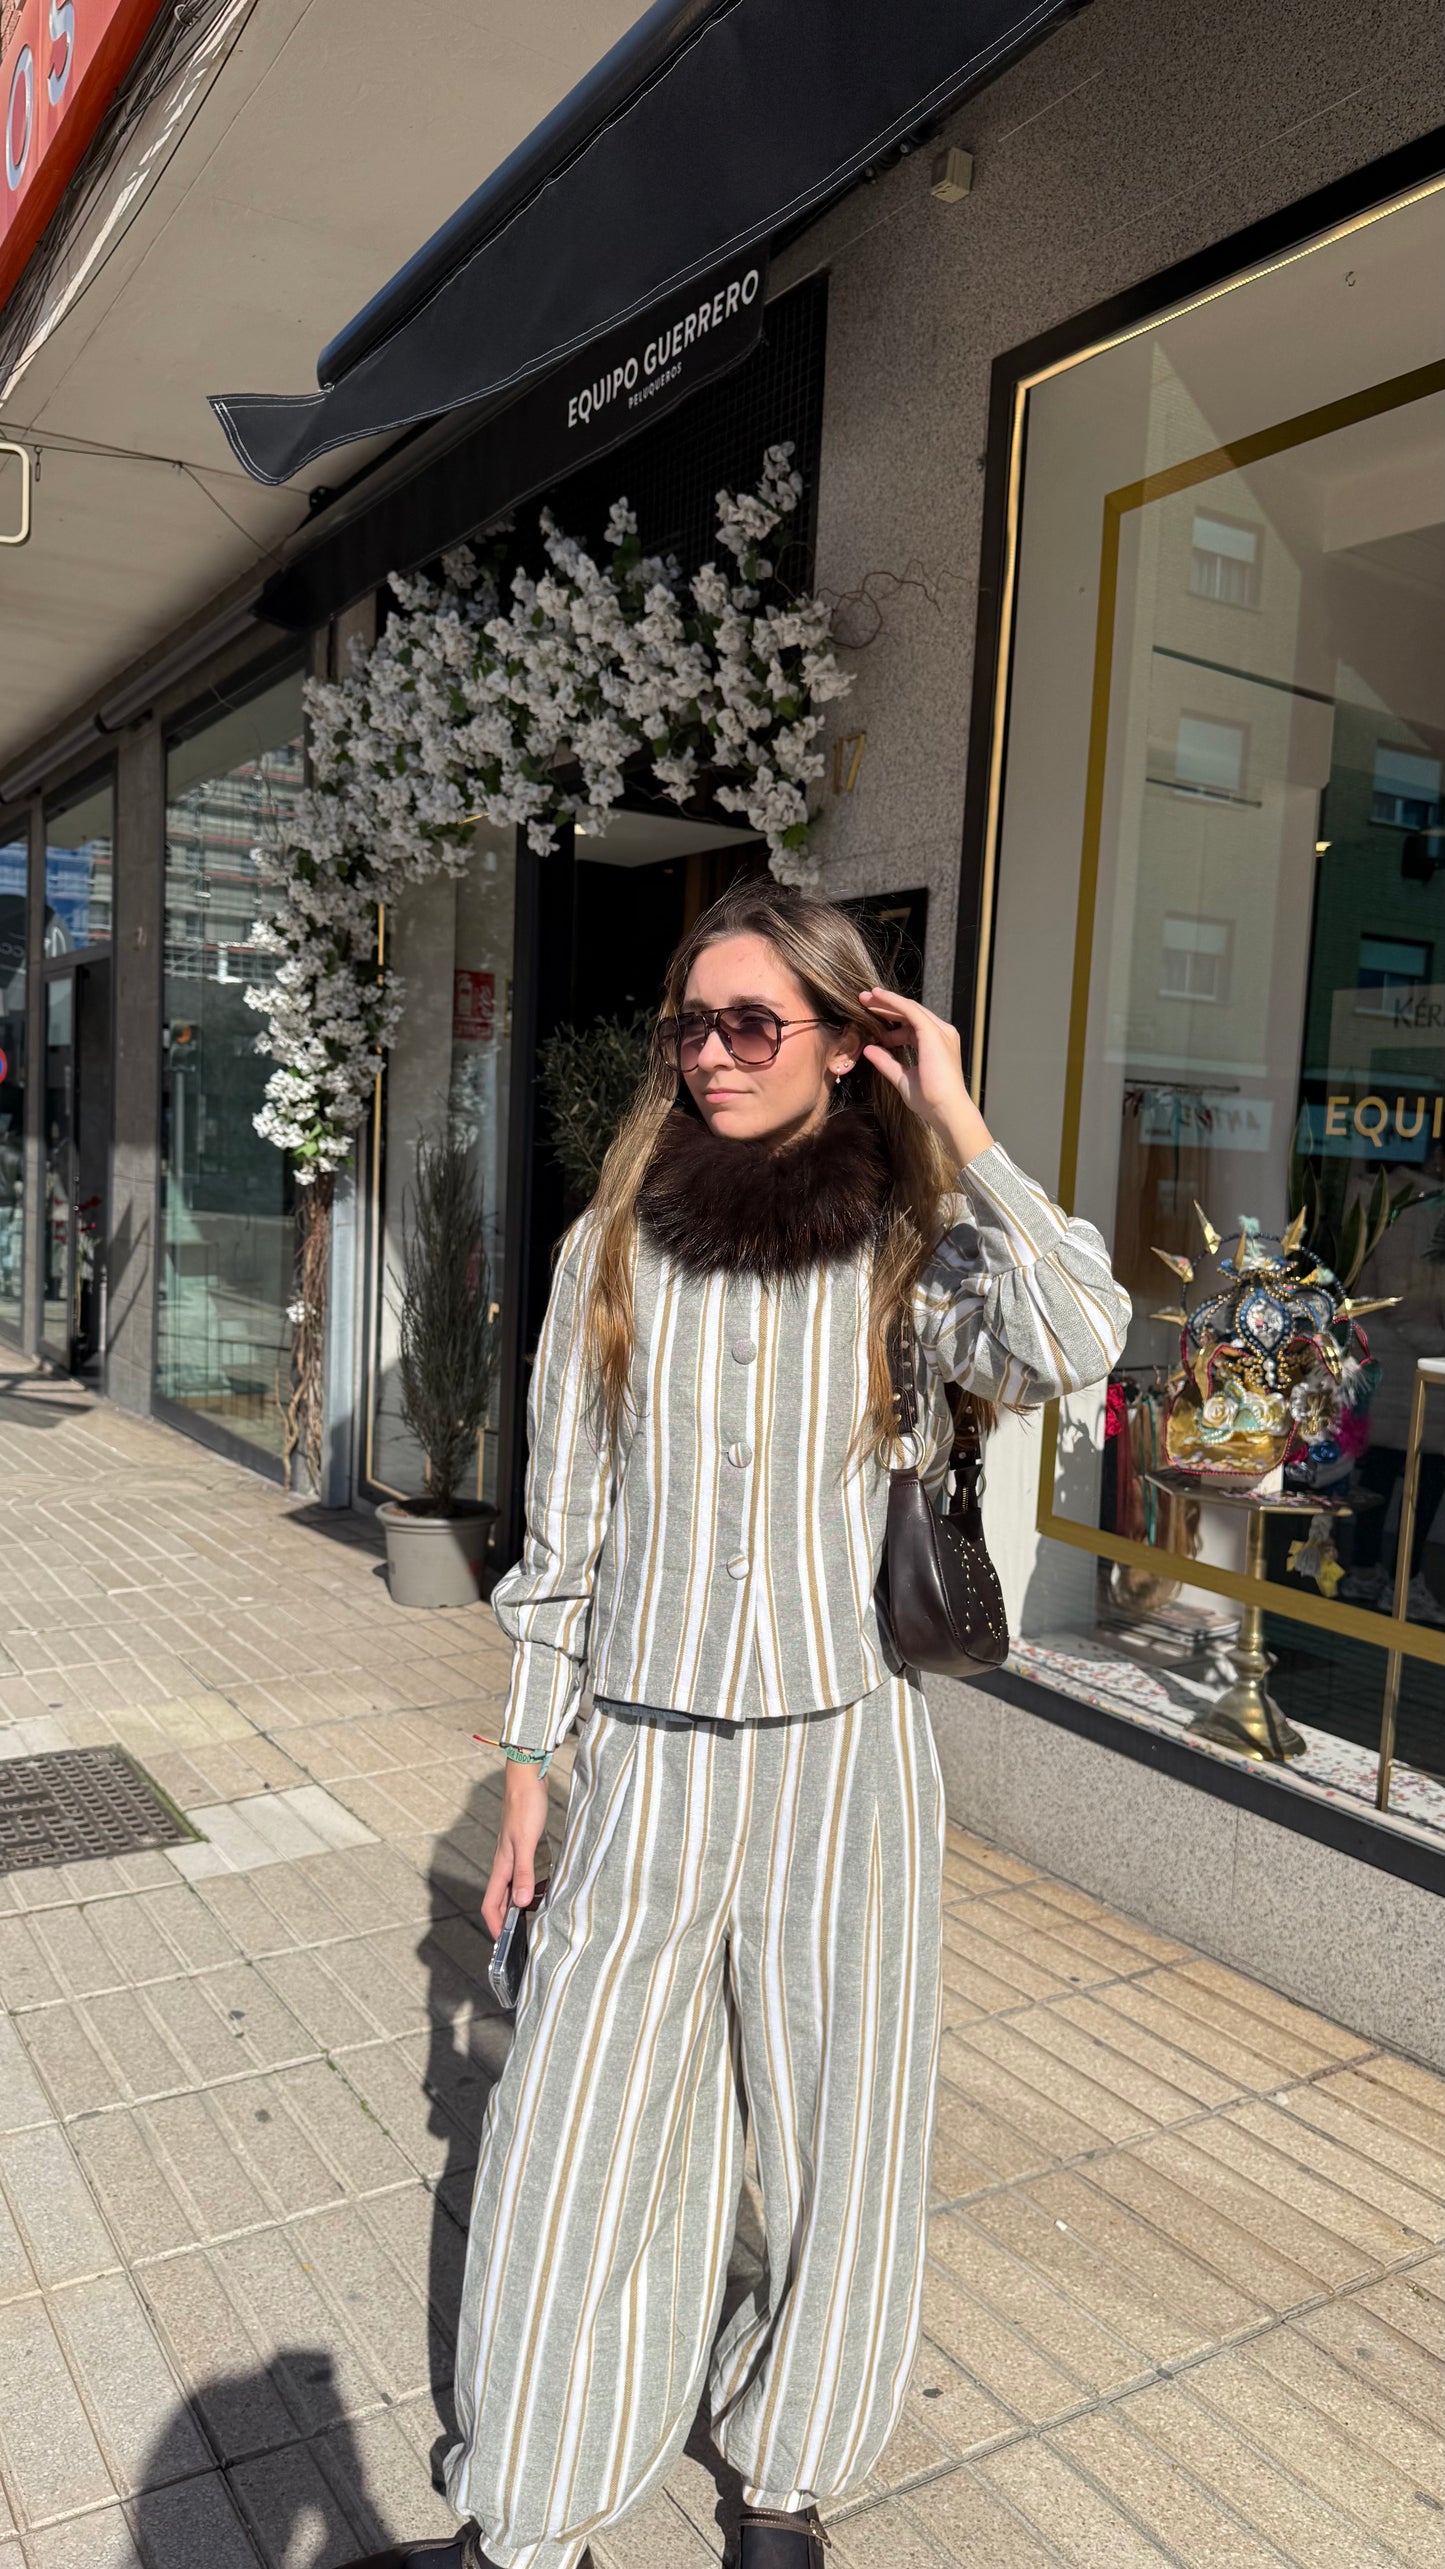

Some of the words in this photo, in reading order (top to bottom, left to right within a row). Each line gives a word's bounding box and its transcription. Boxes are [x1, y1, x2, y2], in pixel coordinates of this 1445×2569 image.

[568, 357, 639, 428] EQUIPO
[644, 269, 759, 375] GUERRERO
[628, 361, 682, 409] PELUQUEROS
[833, 732, 866, 794] 17
[1394, 997, 1445, 1029] KÉR
[1325, 1096, 1444, 1147] EQUI
